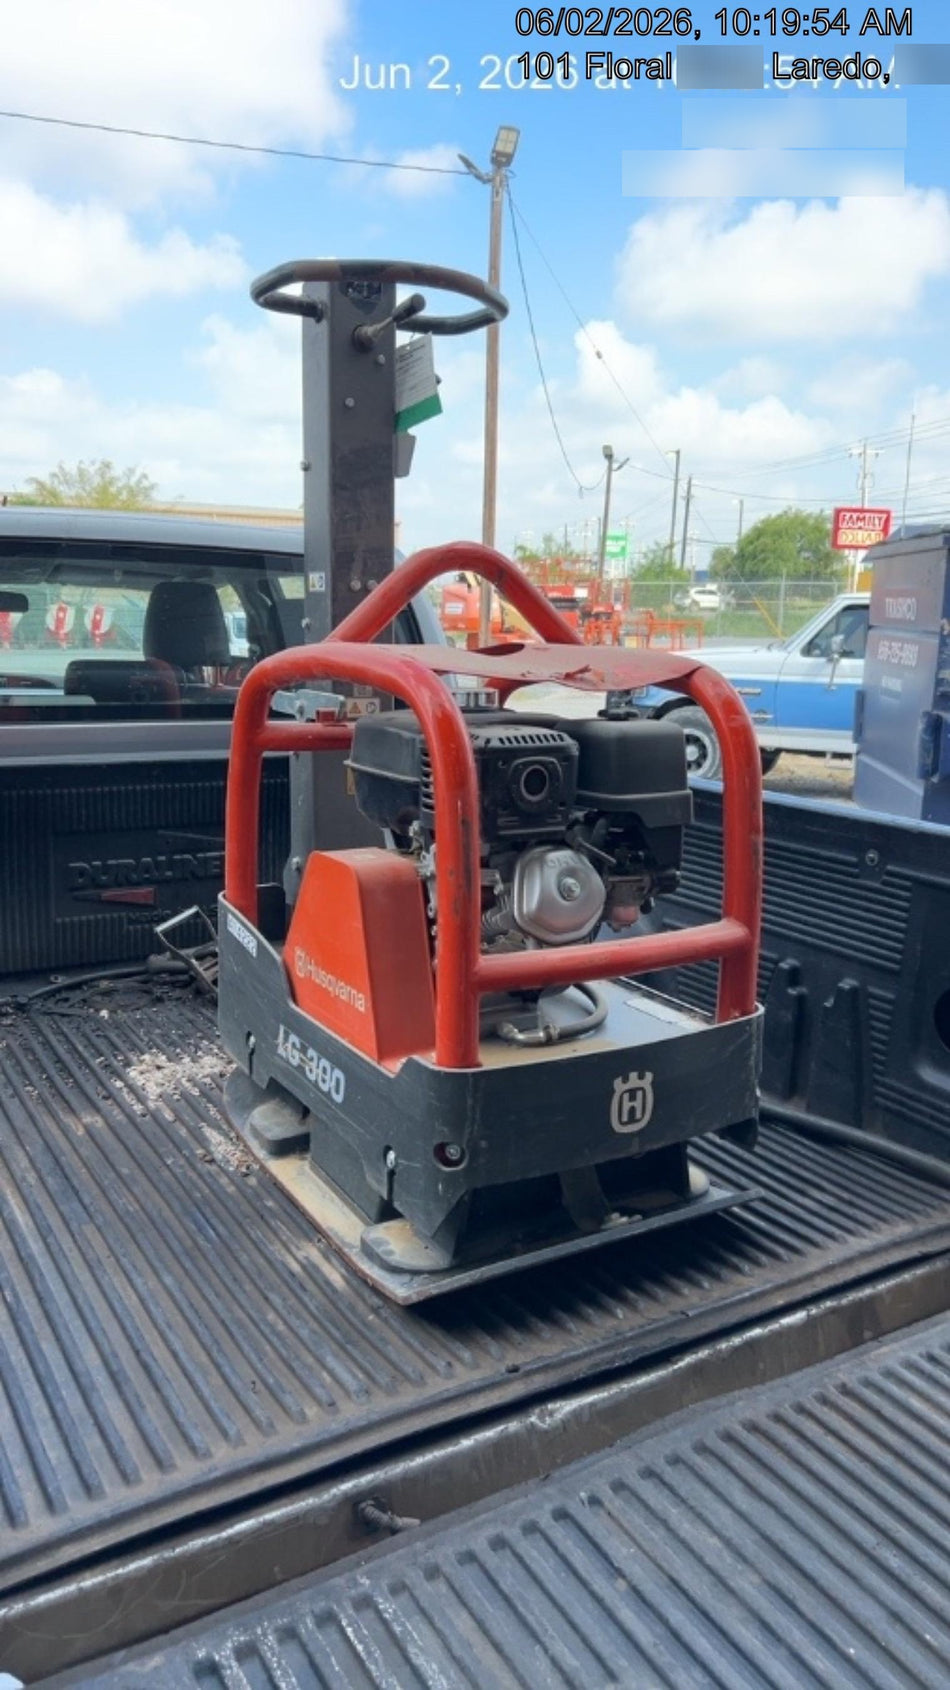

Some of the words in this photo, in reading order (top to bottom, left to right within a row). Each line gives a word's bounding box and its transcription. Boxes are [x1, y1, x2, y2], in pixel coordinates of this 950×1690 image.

[840, 513, 884, 527] FAMILY
[68, 851, 226, 891] DURALINE
[304, 955, 365, 1013] Husqvarna
[276, 1023, 301, 1068] LG
